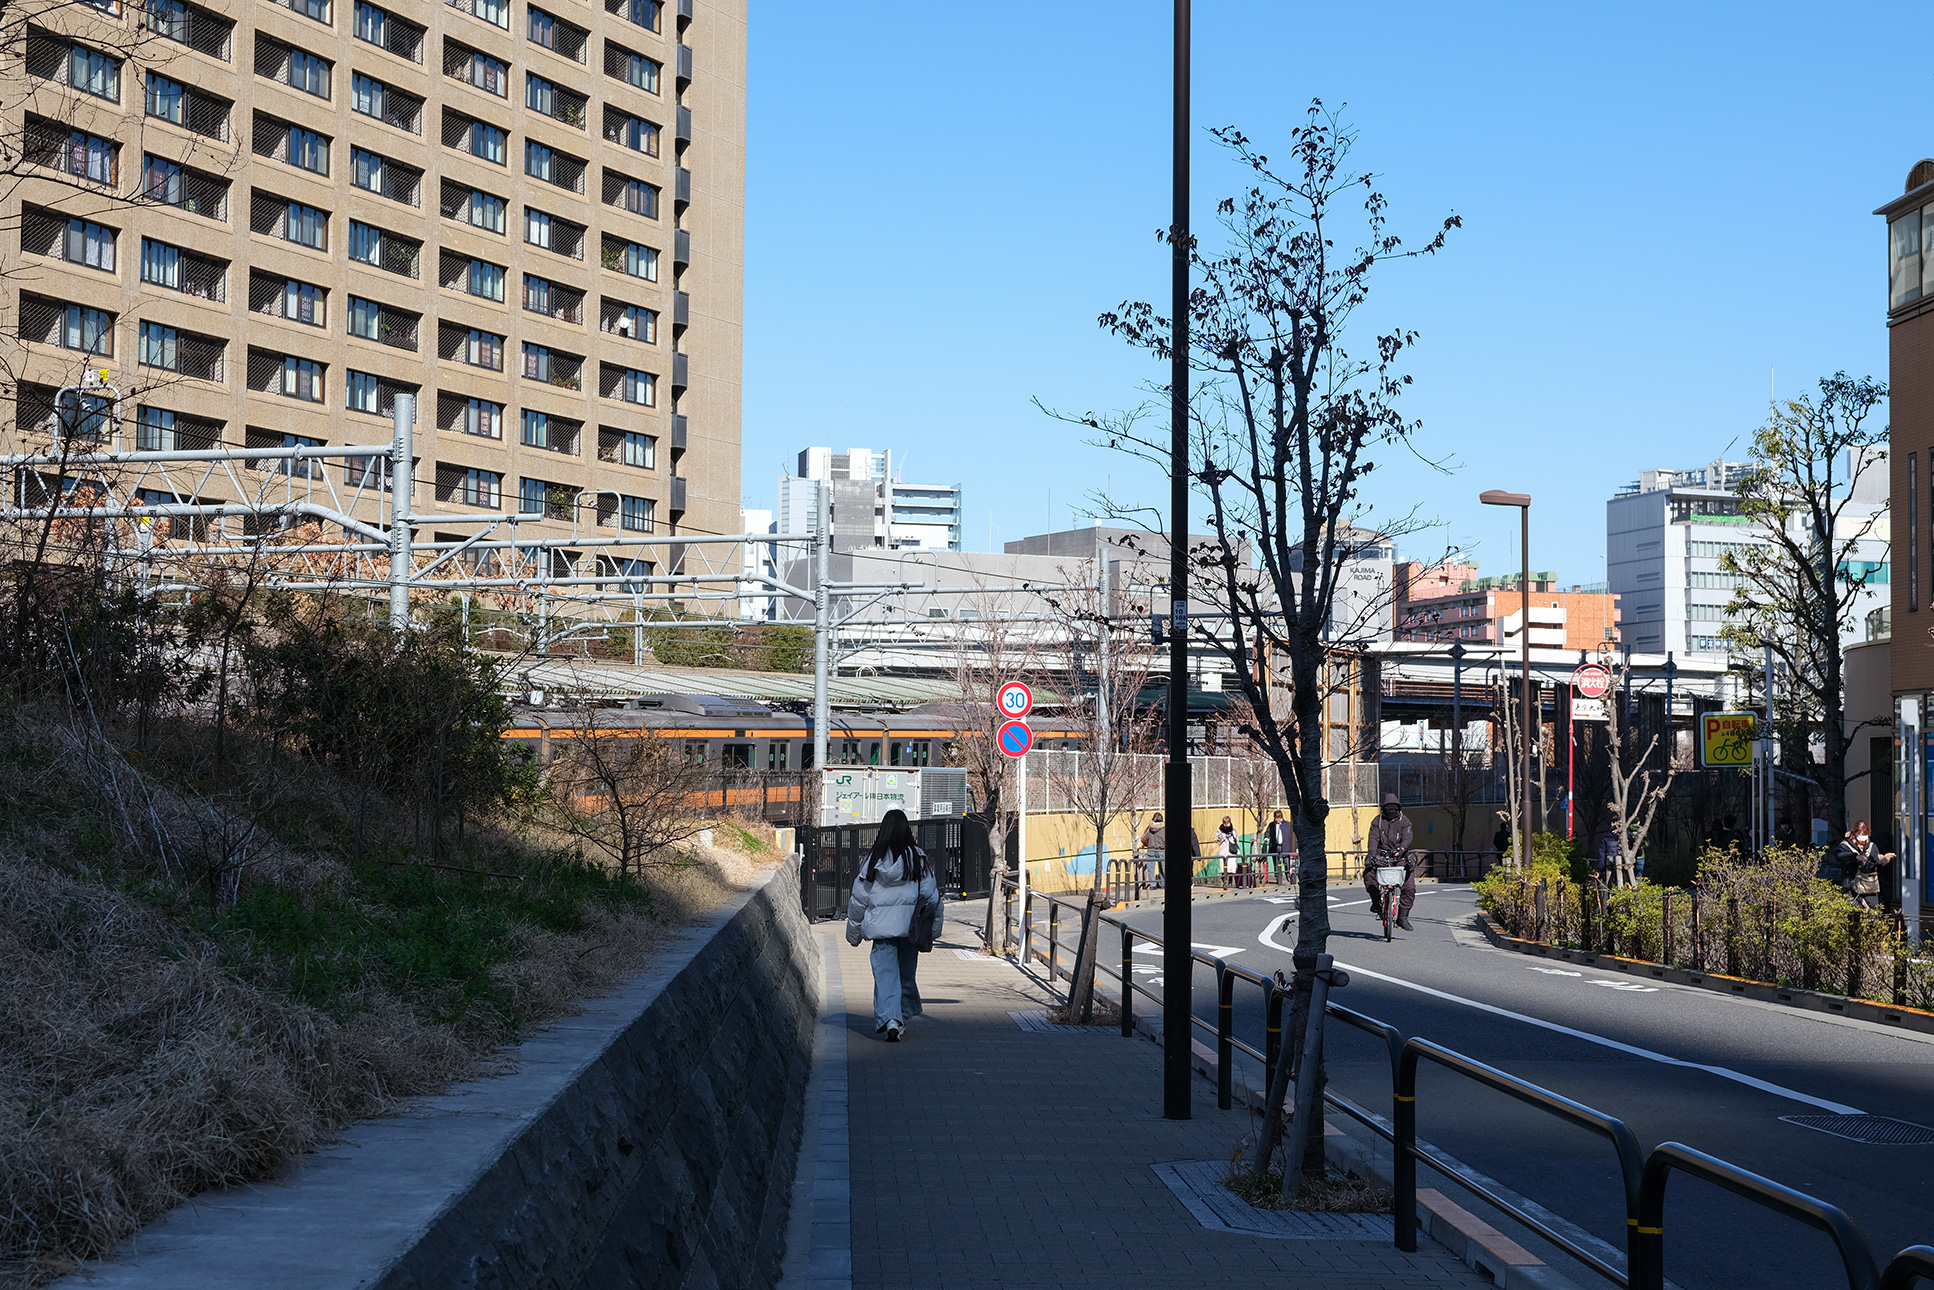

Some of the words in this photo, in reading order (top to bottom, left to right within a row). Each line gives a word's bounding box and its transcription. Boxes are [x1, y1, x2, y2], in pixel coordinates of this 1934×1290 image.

[1581, 677, 1605, 688] 消火栓
[1005, 692, 1025, 708] 30
[1707, 719, 1721, 740] P
[1722, 720, 1750, 729] 自転車
[836, 775, 852, 785] JR
[836, 791, 904, 801] ジェイアール東日本物流
